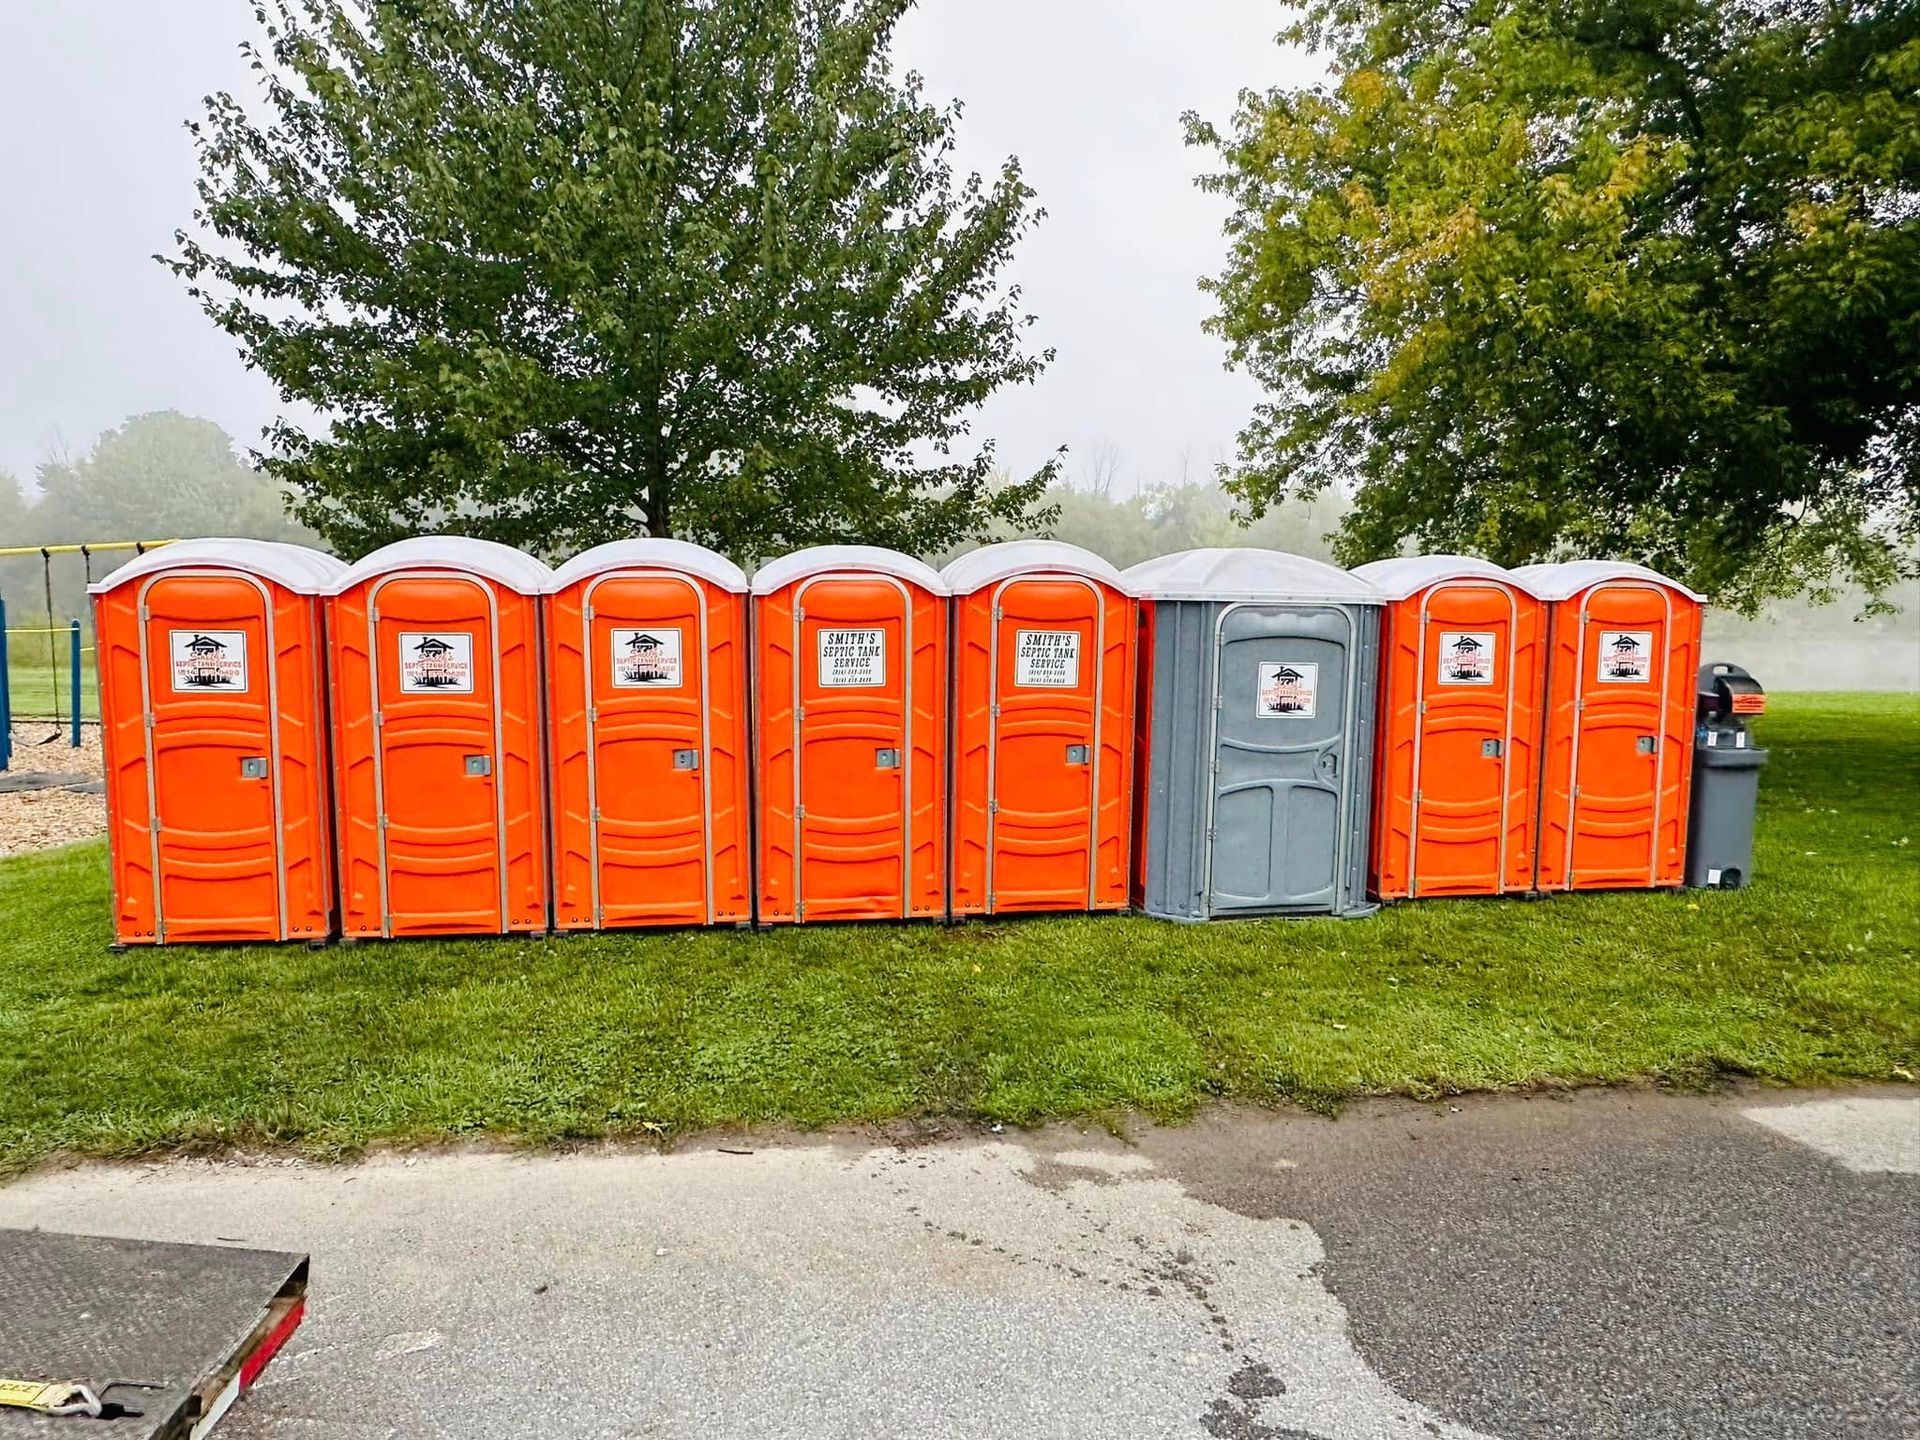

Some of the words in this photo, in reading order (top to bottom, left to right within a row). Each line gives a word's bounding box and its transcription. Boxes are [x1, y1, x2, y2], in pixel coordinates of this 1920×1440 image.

[828, 632, 876, 645] SMITH'S
[1025, 634, 1072, 647] SMITH'S
[823, 646, 855, 657] SEPTIC
[858, 646, 881, 657] TANK
[1020, 647, 1051, 658] SEPTIC
[1054, 648, 1075, 659] TANK
[834, 657, 871, 668] SERVICE
[1030, 658, 1065, 669] SERVICE
